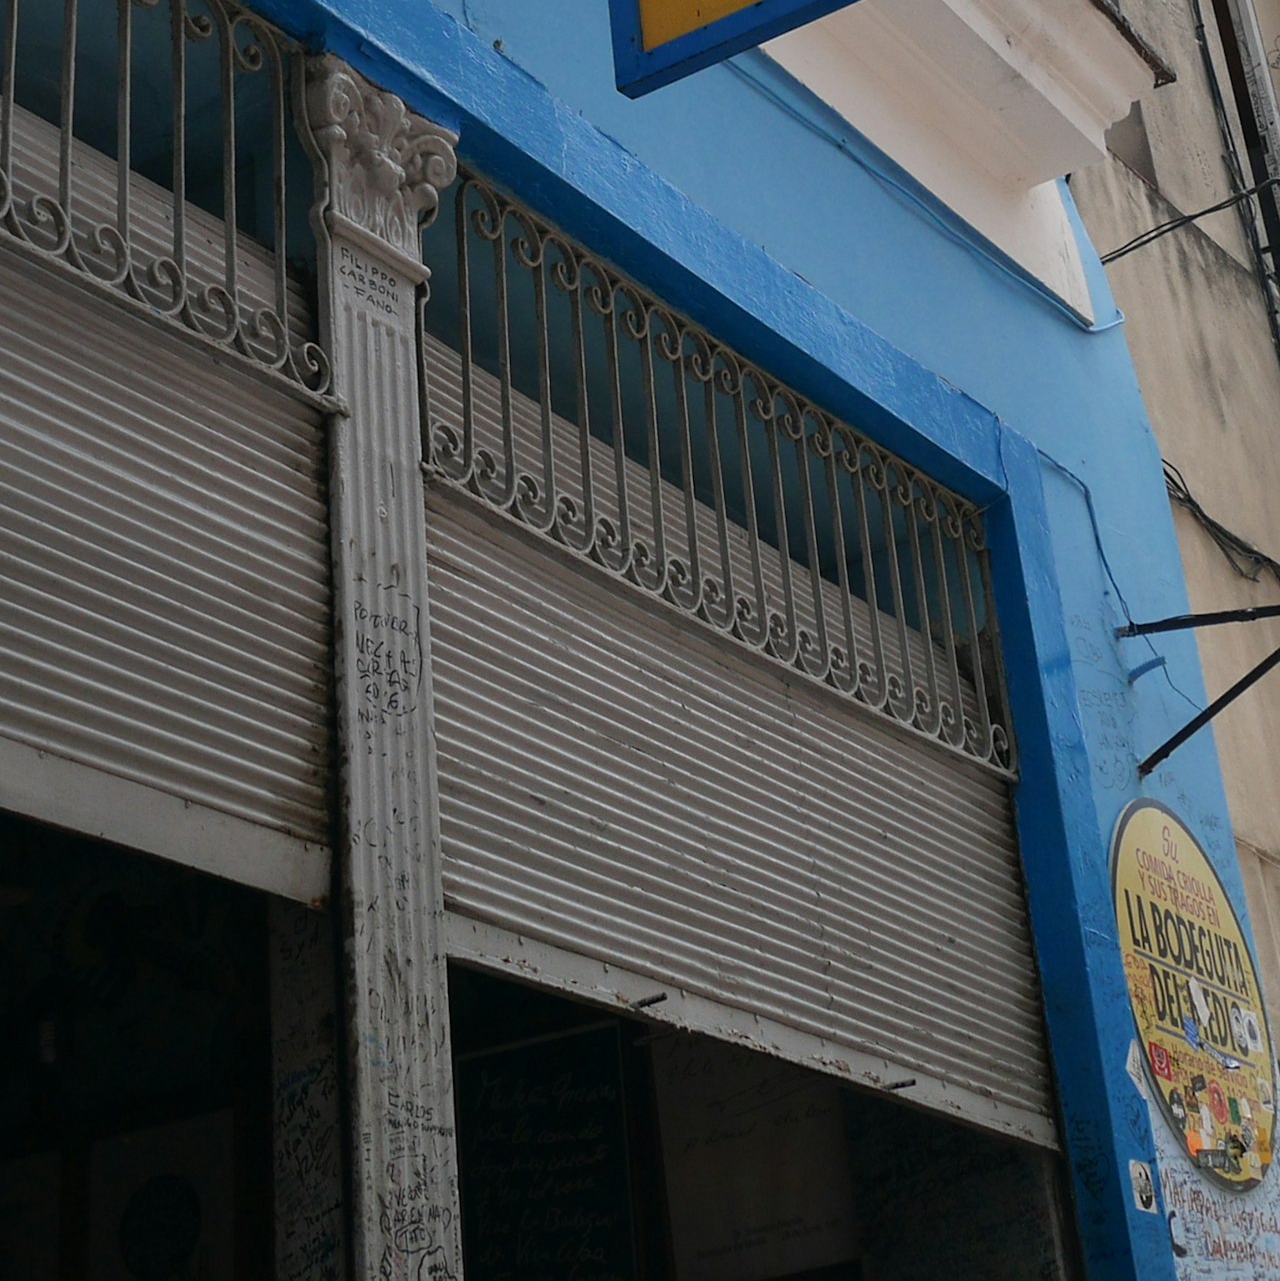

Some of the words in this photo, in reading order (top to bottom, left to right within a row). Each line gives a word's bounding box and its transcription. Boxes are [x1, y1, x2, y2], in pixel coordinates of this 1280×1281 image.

[1136, 847, 1176, 887] COMIDA
[1176, 868, 1216, 905] CRIOLLA
[1138, 870, 1146, 891] Y
[1148, 877, 1168, 901] SUS
[1167, 882, 1208, 922] TRAGOS
[1207, 906, 1221, 929] EN
[1124, 888, 1153, 953] LA
[1149, 900, 1250, 997] BODEGUITA
